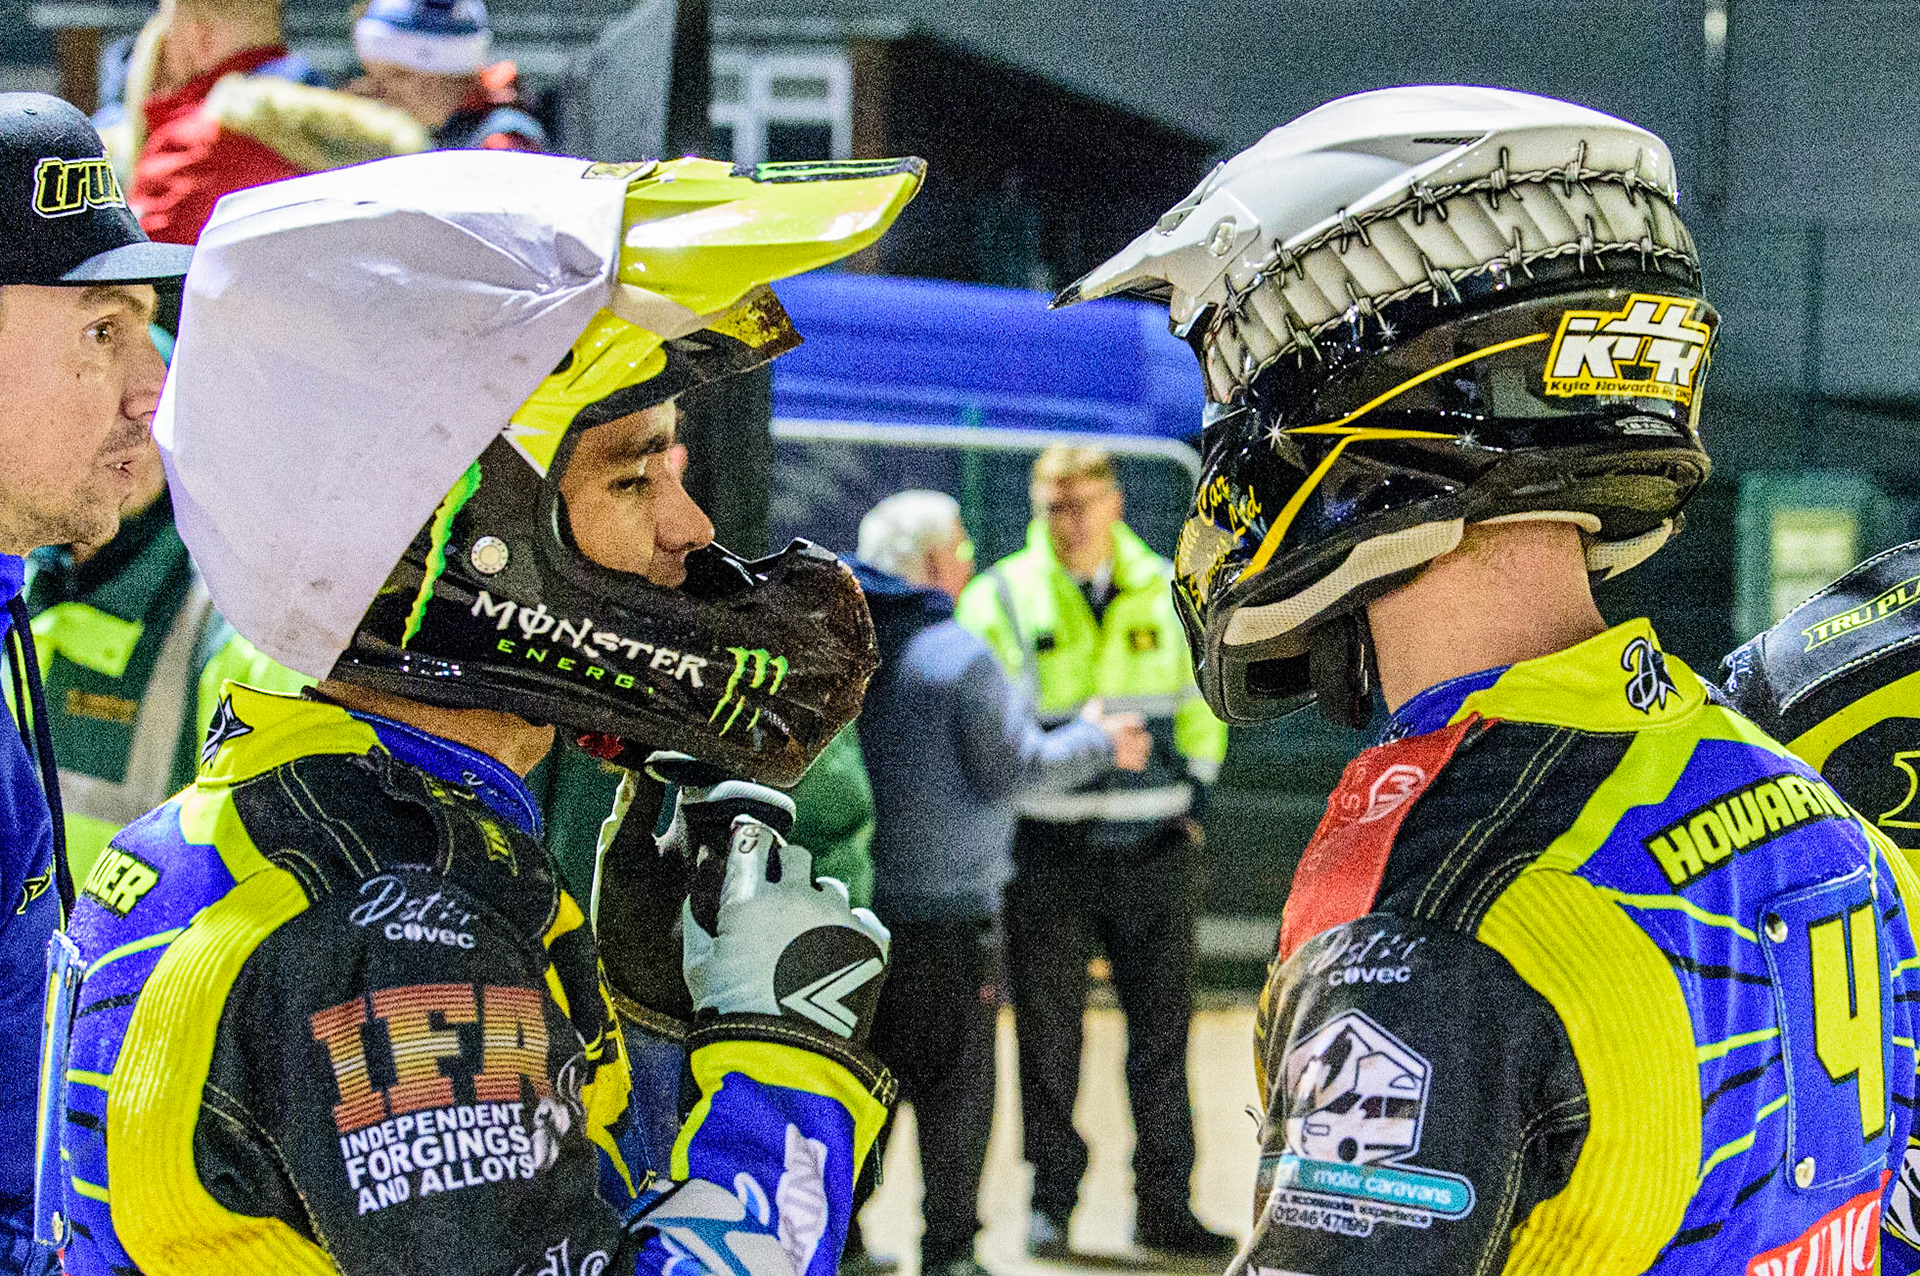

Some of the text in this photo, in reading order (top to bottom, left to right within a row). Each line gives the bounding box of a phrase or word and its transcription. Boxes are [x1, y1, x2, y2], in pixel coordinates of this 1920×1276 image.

[1812, 607, 1873, 641] TRU
[497, 638, 654, 695] ENERG
[1810, 902, 1886, 1139] 4
[339, 1103, 523, 1159] INDEPENDENT
[346, 1125, 531, 1189] FORGINGS
[358, 1153, 535, 1215] AND ALLOYS
[1365, 1171, 1452, 1206] caravans
